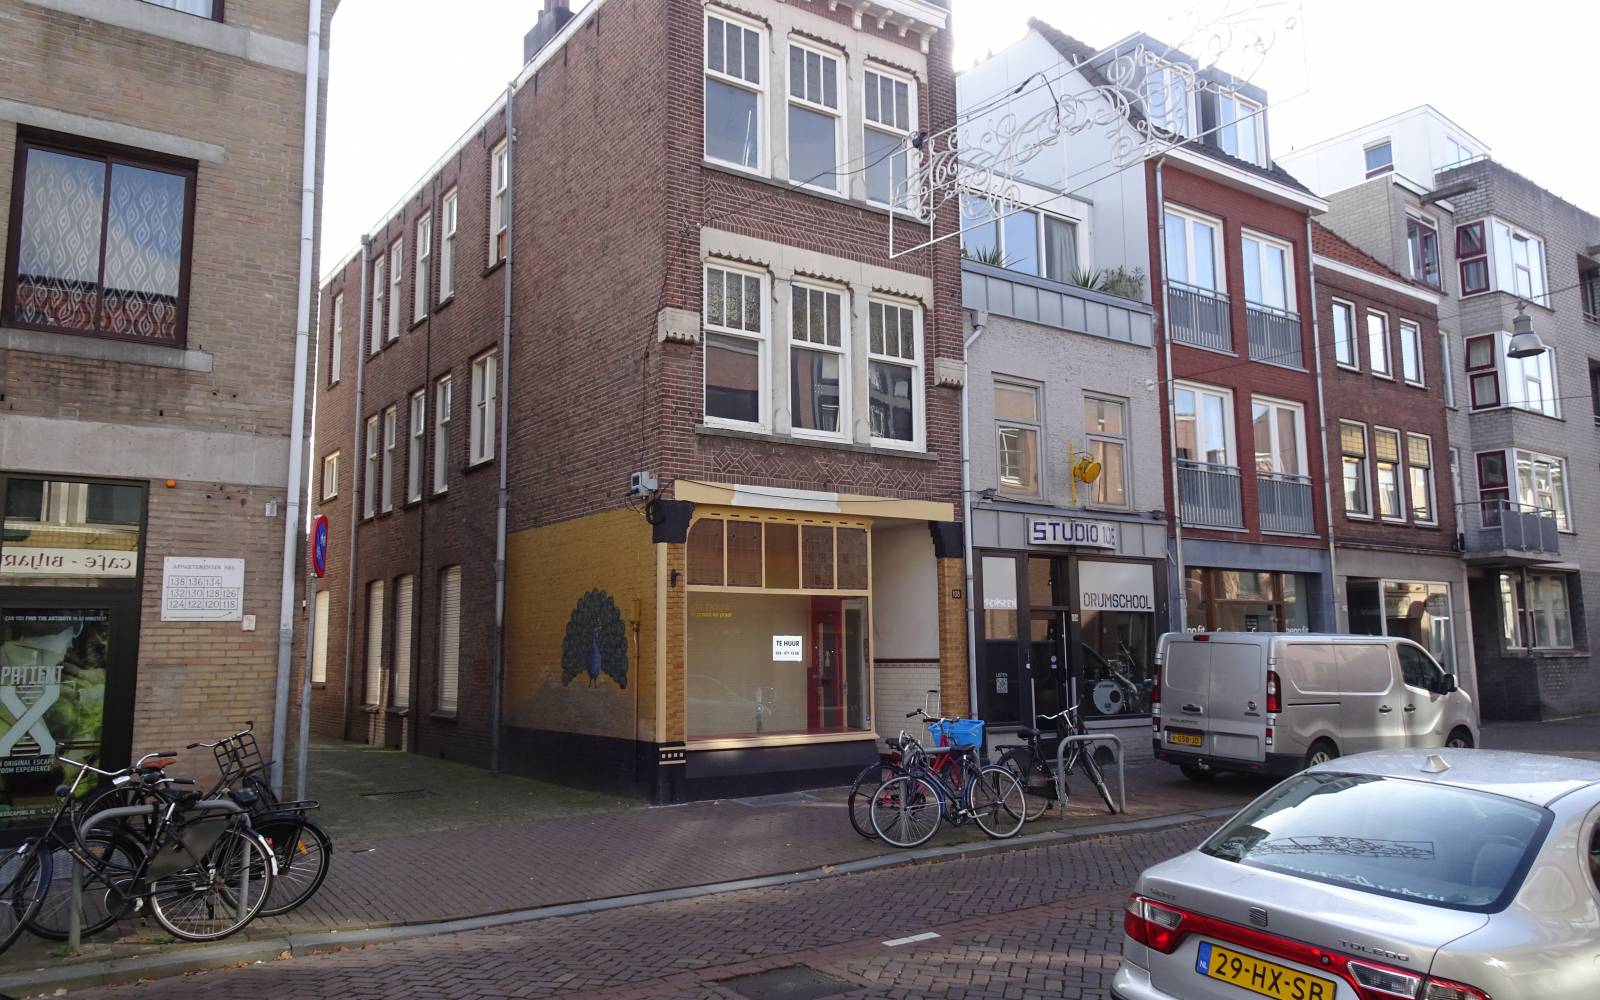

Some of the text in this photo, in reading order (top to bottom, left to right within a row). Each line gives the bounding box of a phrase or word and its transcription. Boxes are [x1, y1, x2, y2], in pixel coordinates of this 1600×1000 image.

[1033, 522, 1099, 543] STUDIO
[170, 577, 221, 587] 138 136 134
[170, 589, 237, 598] 132 130 128 126
[1083, 592, 1153, 610] DRUMSCHOOL
[169, 600, 236, 609] 124 122 120 118
[0, 665, 64, 685] PATIENT
[16, 765, 50, 773] EXPERIENCE
[1341, 940, 1409, 962] TOLEDO
[1199, 952, 1324, 1000] NL 29-HX-SB
